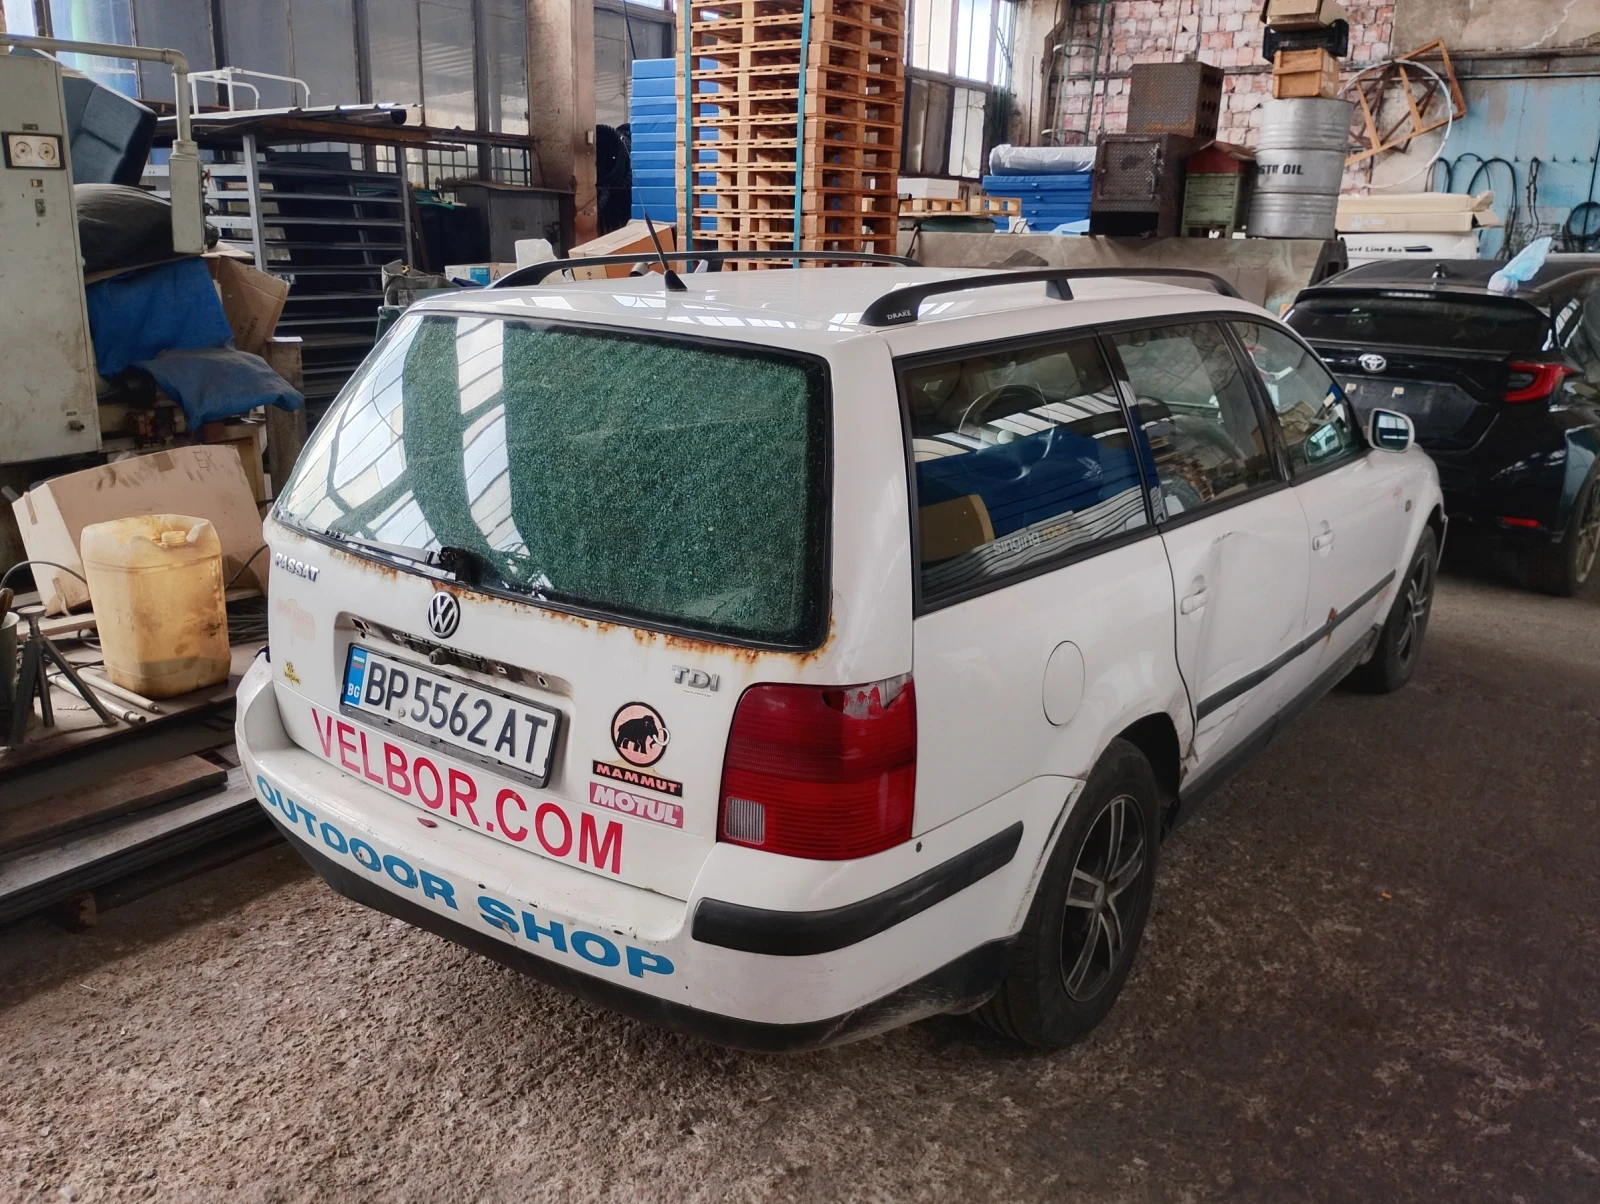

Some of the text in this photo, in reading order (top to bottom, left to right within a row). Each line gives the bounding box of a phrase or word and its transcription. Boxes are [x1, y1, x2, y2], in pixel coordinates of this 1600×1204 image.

[1282, 164, 1304, 175] OIL
[886, 309, 912, 320] DRAKE
[992, 531, 1040, 553] singing
[275, 551, 320, 582] PASSAT
[347, 682, 361, 699] BG
[671, 664, 721, 692] TDI
[311, 707, 624, 875] VELBOR.COM
[596, 763, 677, 794] MAMMUT
[256, 774, 675, 979] OUTDOOR SHOP
